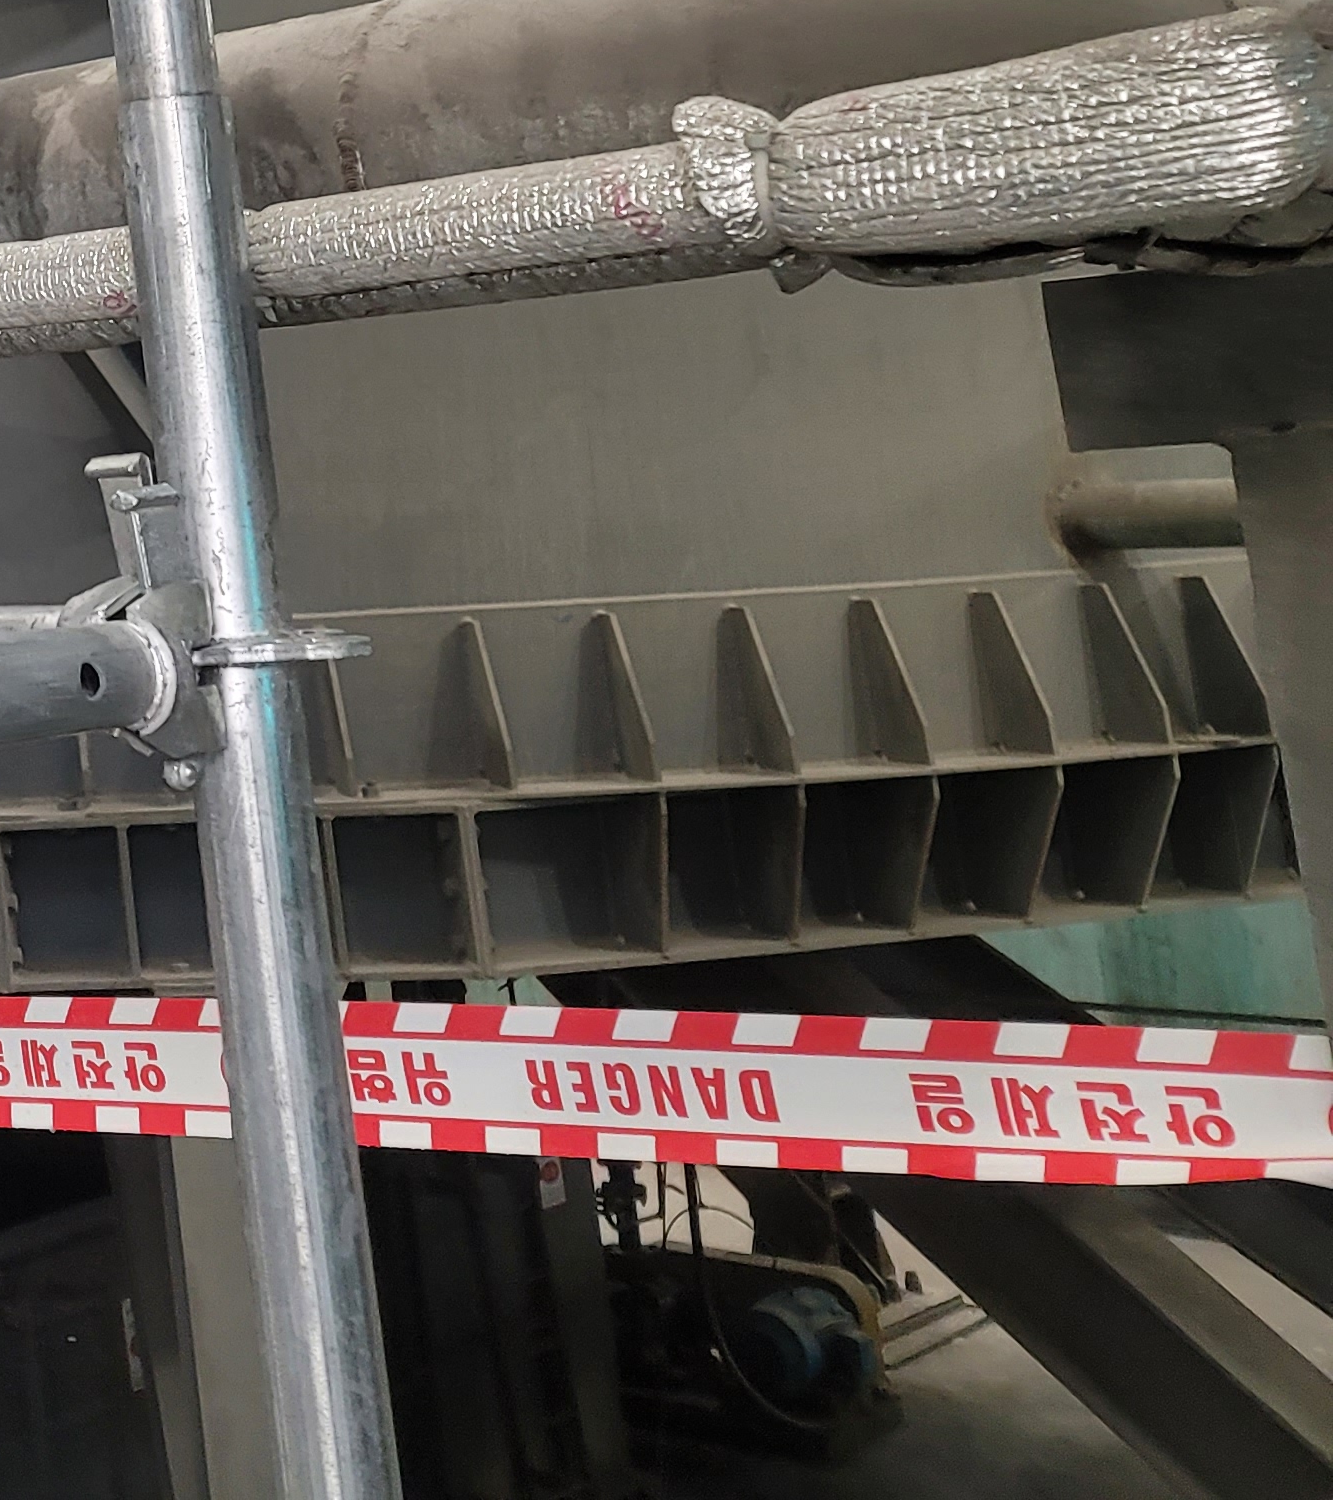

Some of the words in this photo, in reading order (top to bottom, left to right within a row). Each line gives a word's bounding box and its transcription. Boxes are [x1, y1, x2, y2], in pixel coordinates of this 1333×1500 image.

[346, 1048, 452, 1107] 위험
[524, 1059, 780, 1123] DANGER
[908, 1072, 1237, 1149] 안전제일
